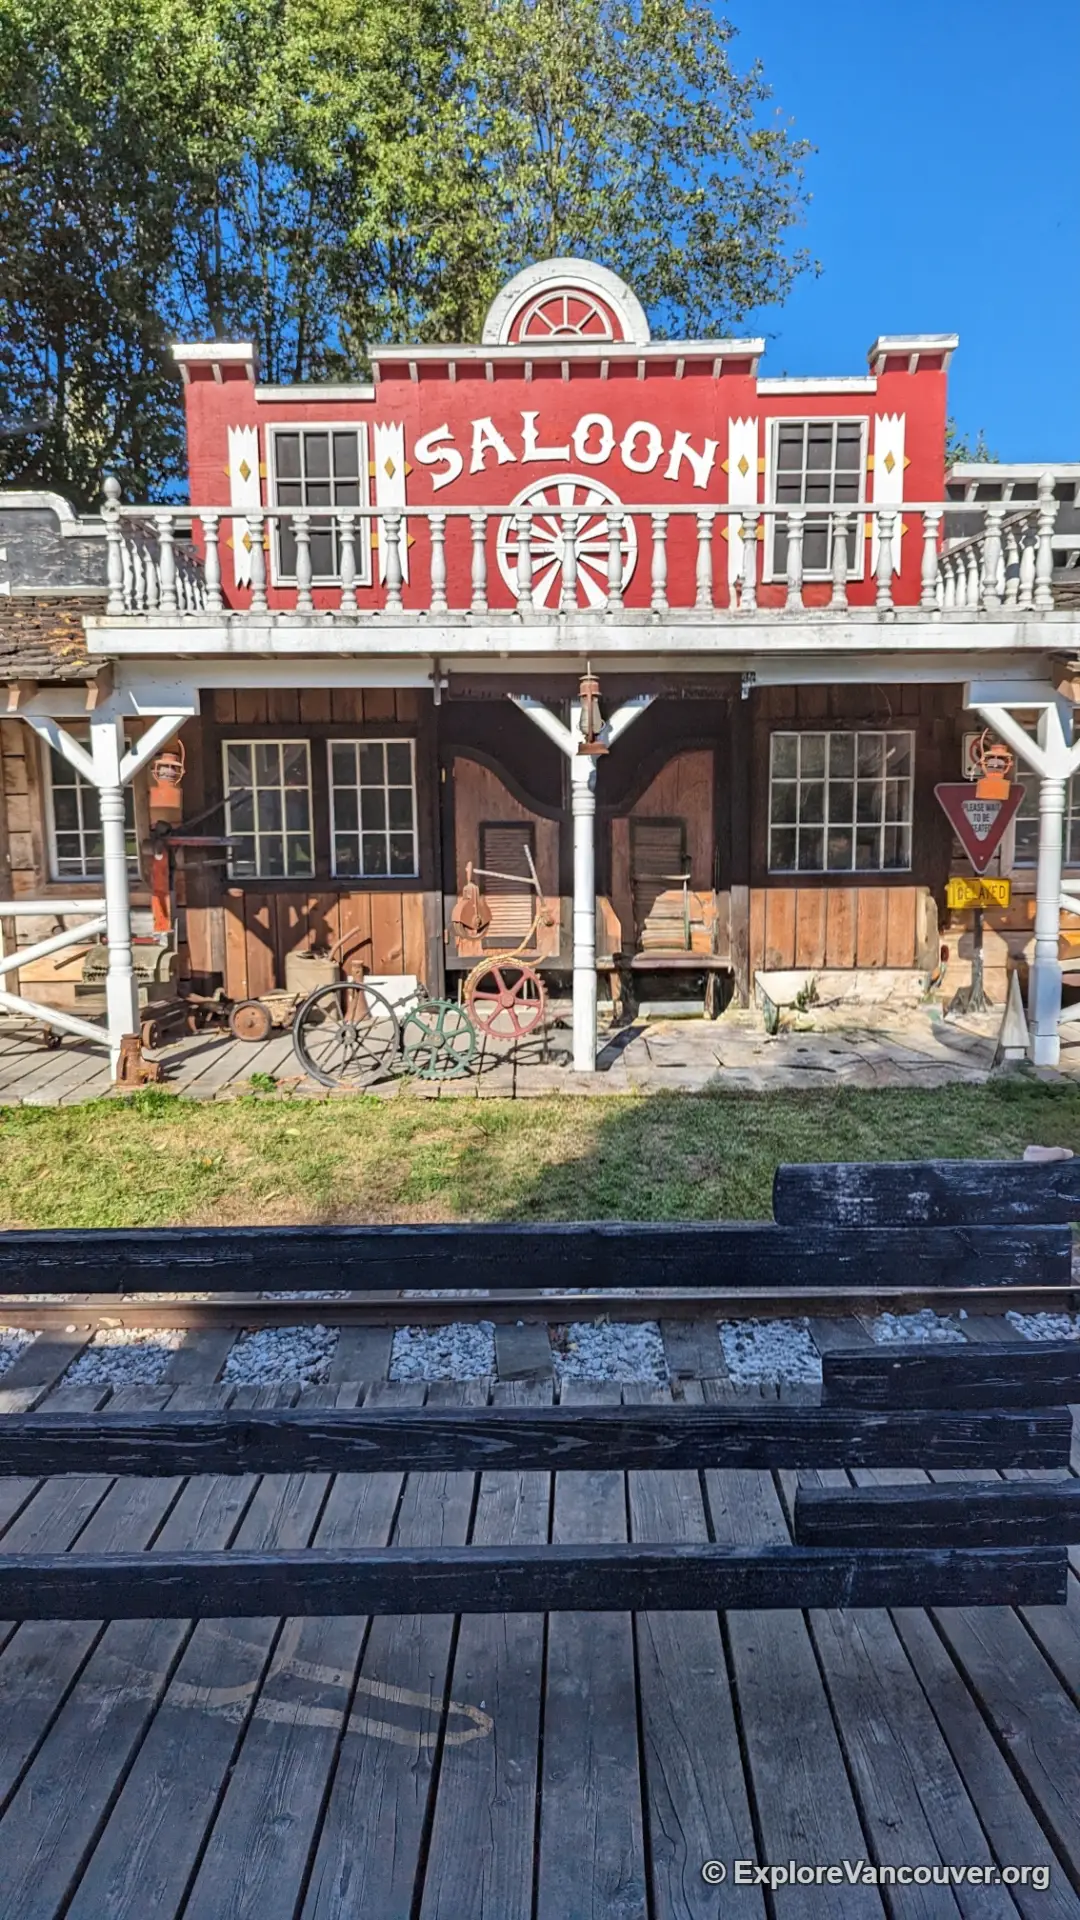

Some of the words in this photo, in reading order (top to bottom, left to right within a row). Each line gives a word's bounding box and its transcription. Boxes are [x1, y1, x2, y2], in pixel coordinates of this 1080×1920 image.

[414, 411, 719, 491] SALOON
[963, 803, 984, 811] LEASE
[973, 813, 981, 822] TO
[982, 813, 990, 822] BE
